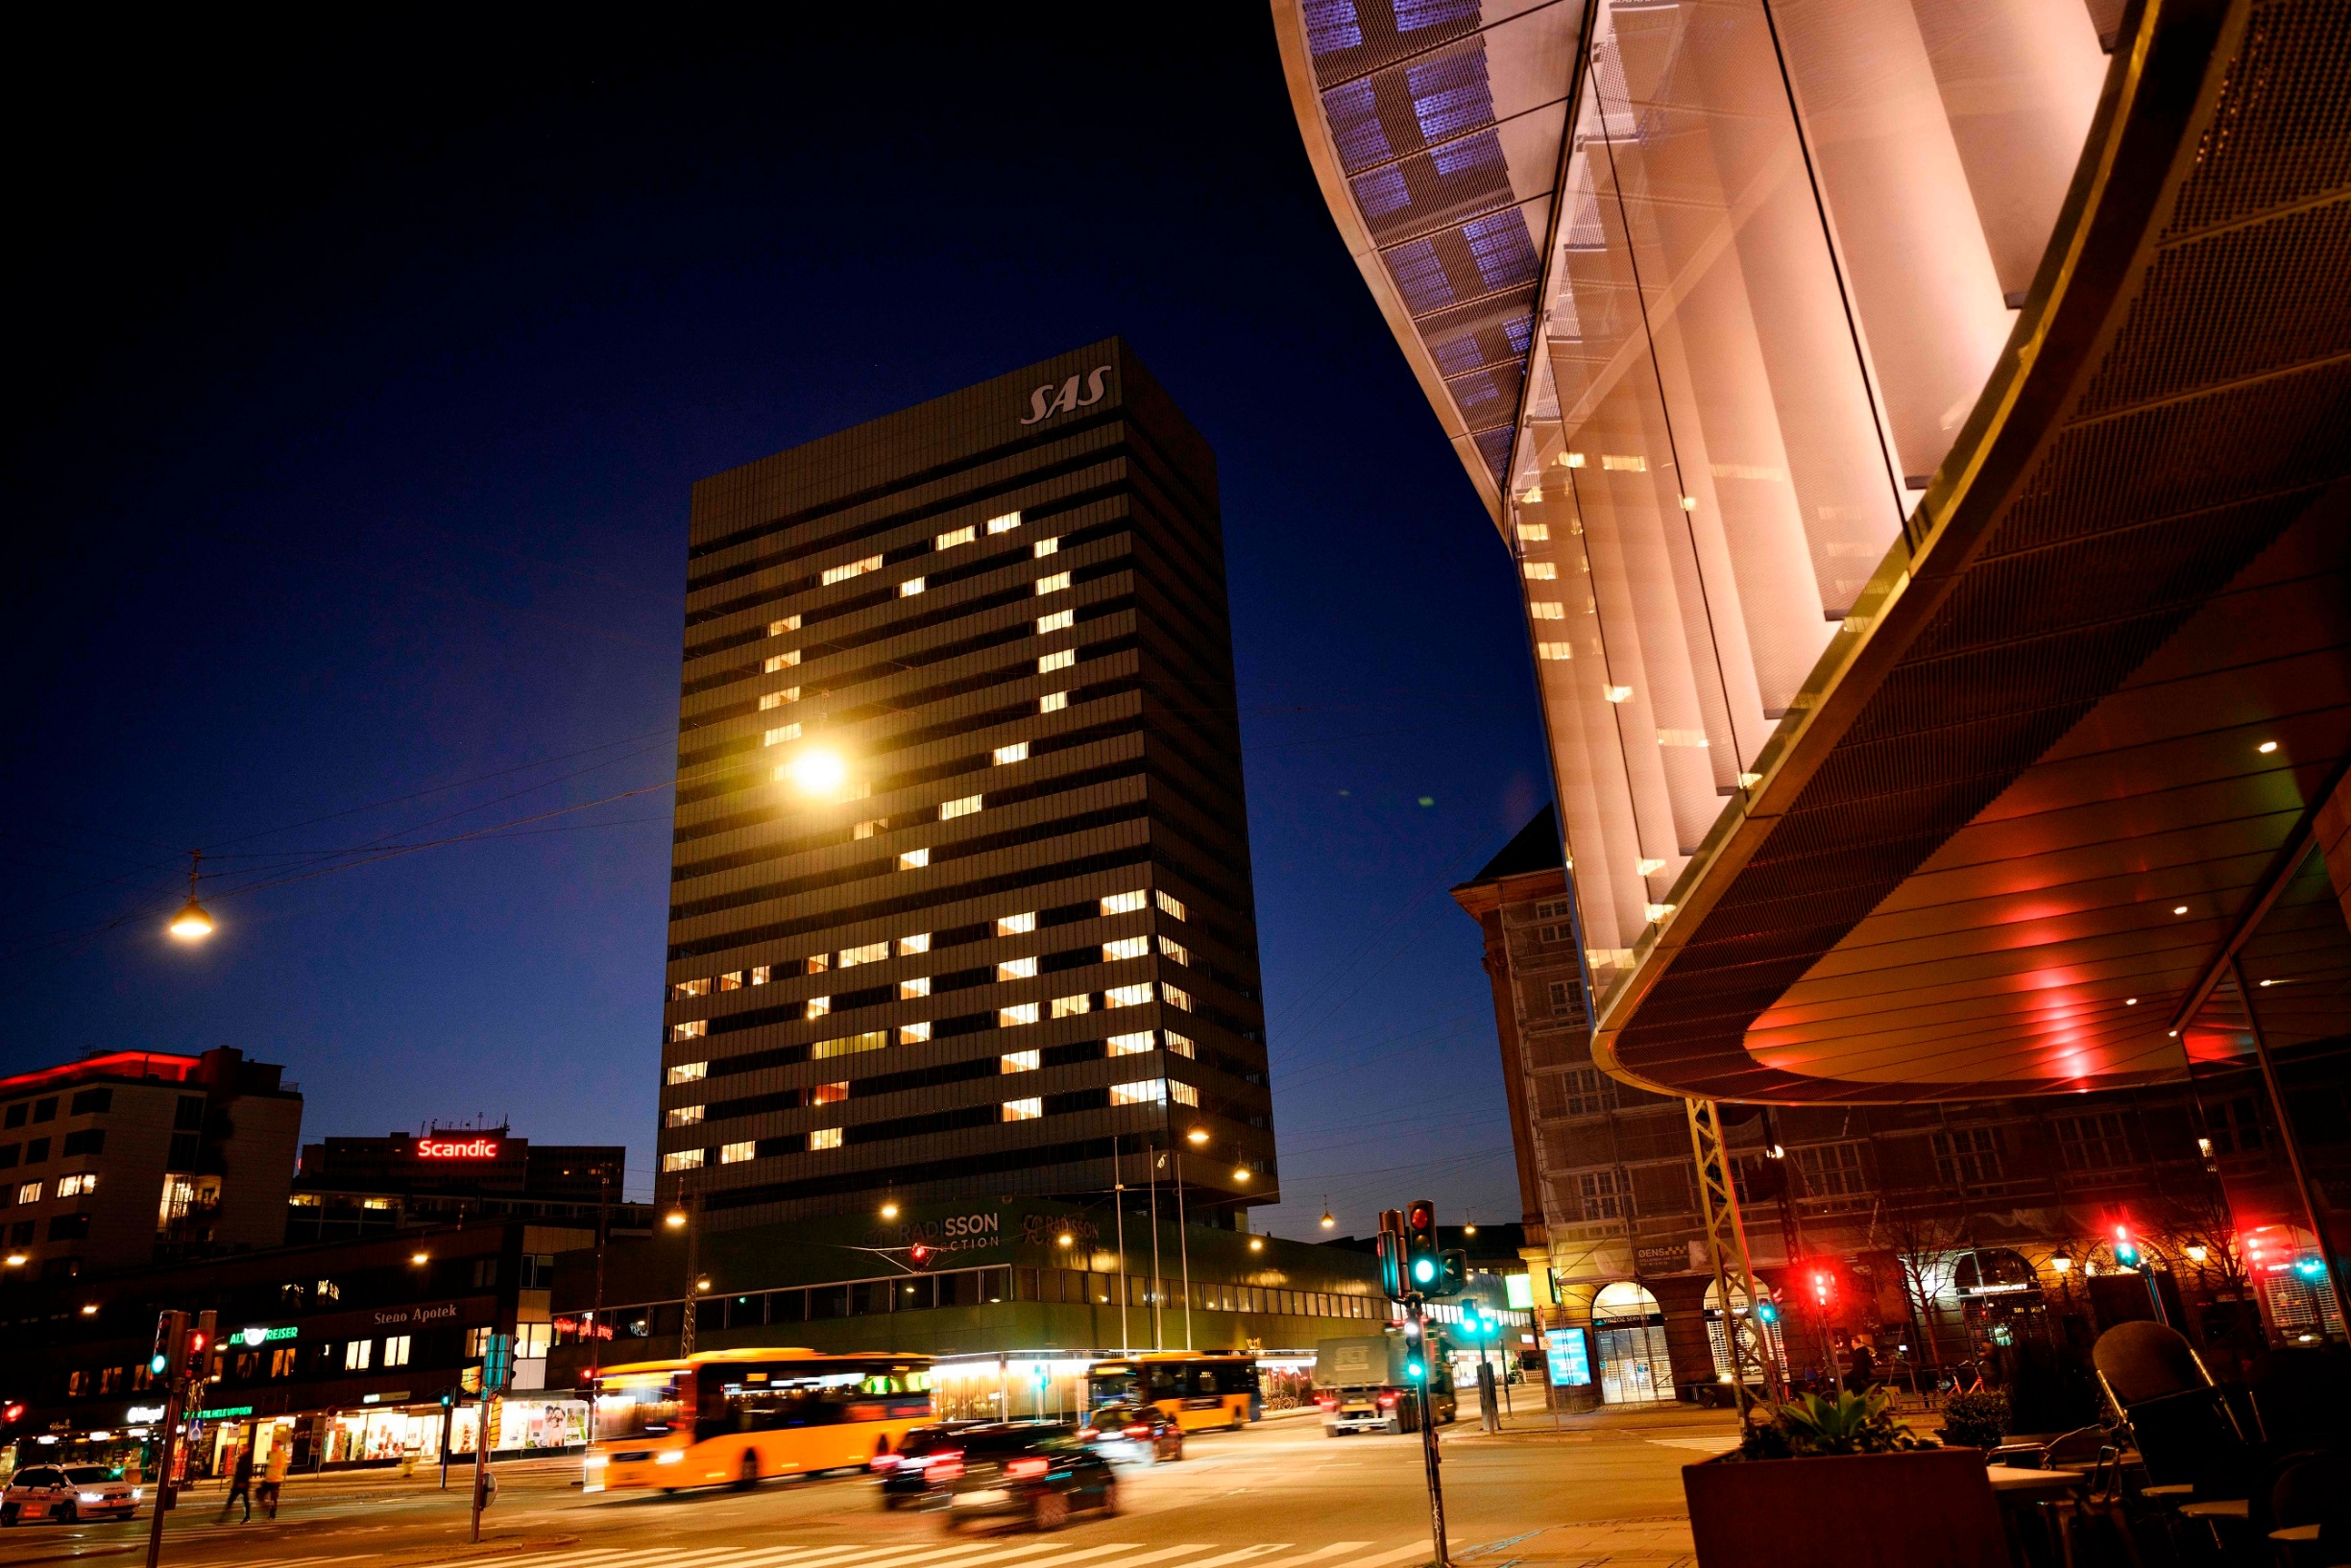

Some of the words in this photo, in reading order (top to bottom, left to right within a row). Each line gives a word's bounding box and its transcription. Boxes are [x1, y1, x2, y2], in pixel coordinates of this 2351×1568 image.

[1020, 365, 1112, 425] SAS
[418, 1140, 497, 1157] Scandic
[1638, 1248, 1664, 1258] ØENS
[374, 1313, 408, 1325] Steno
[412, 1304, 457, 1323] Apotek
